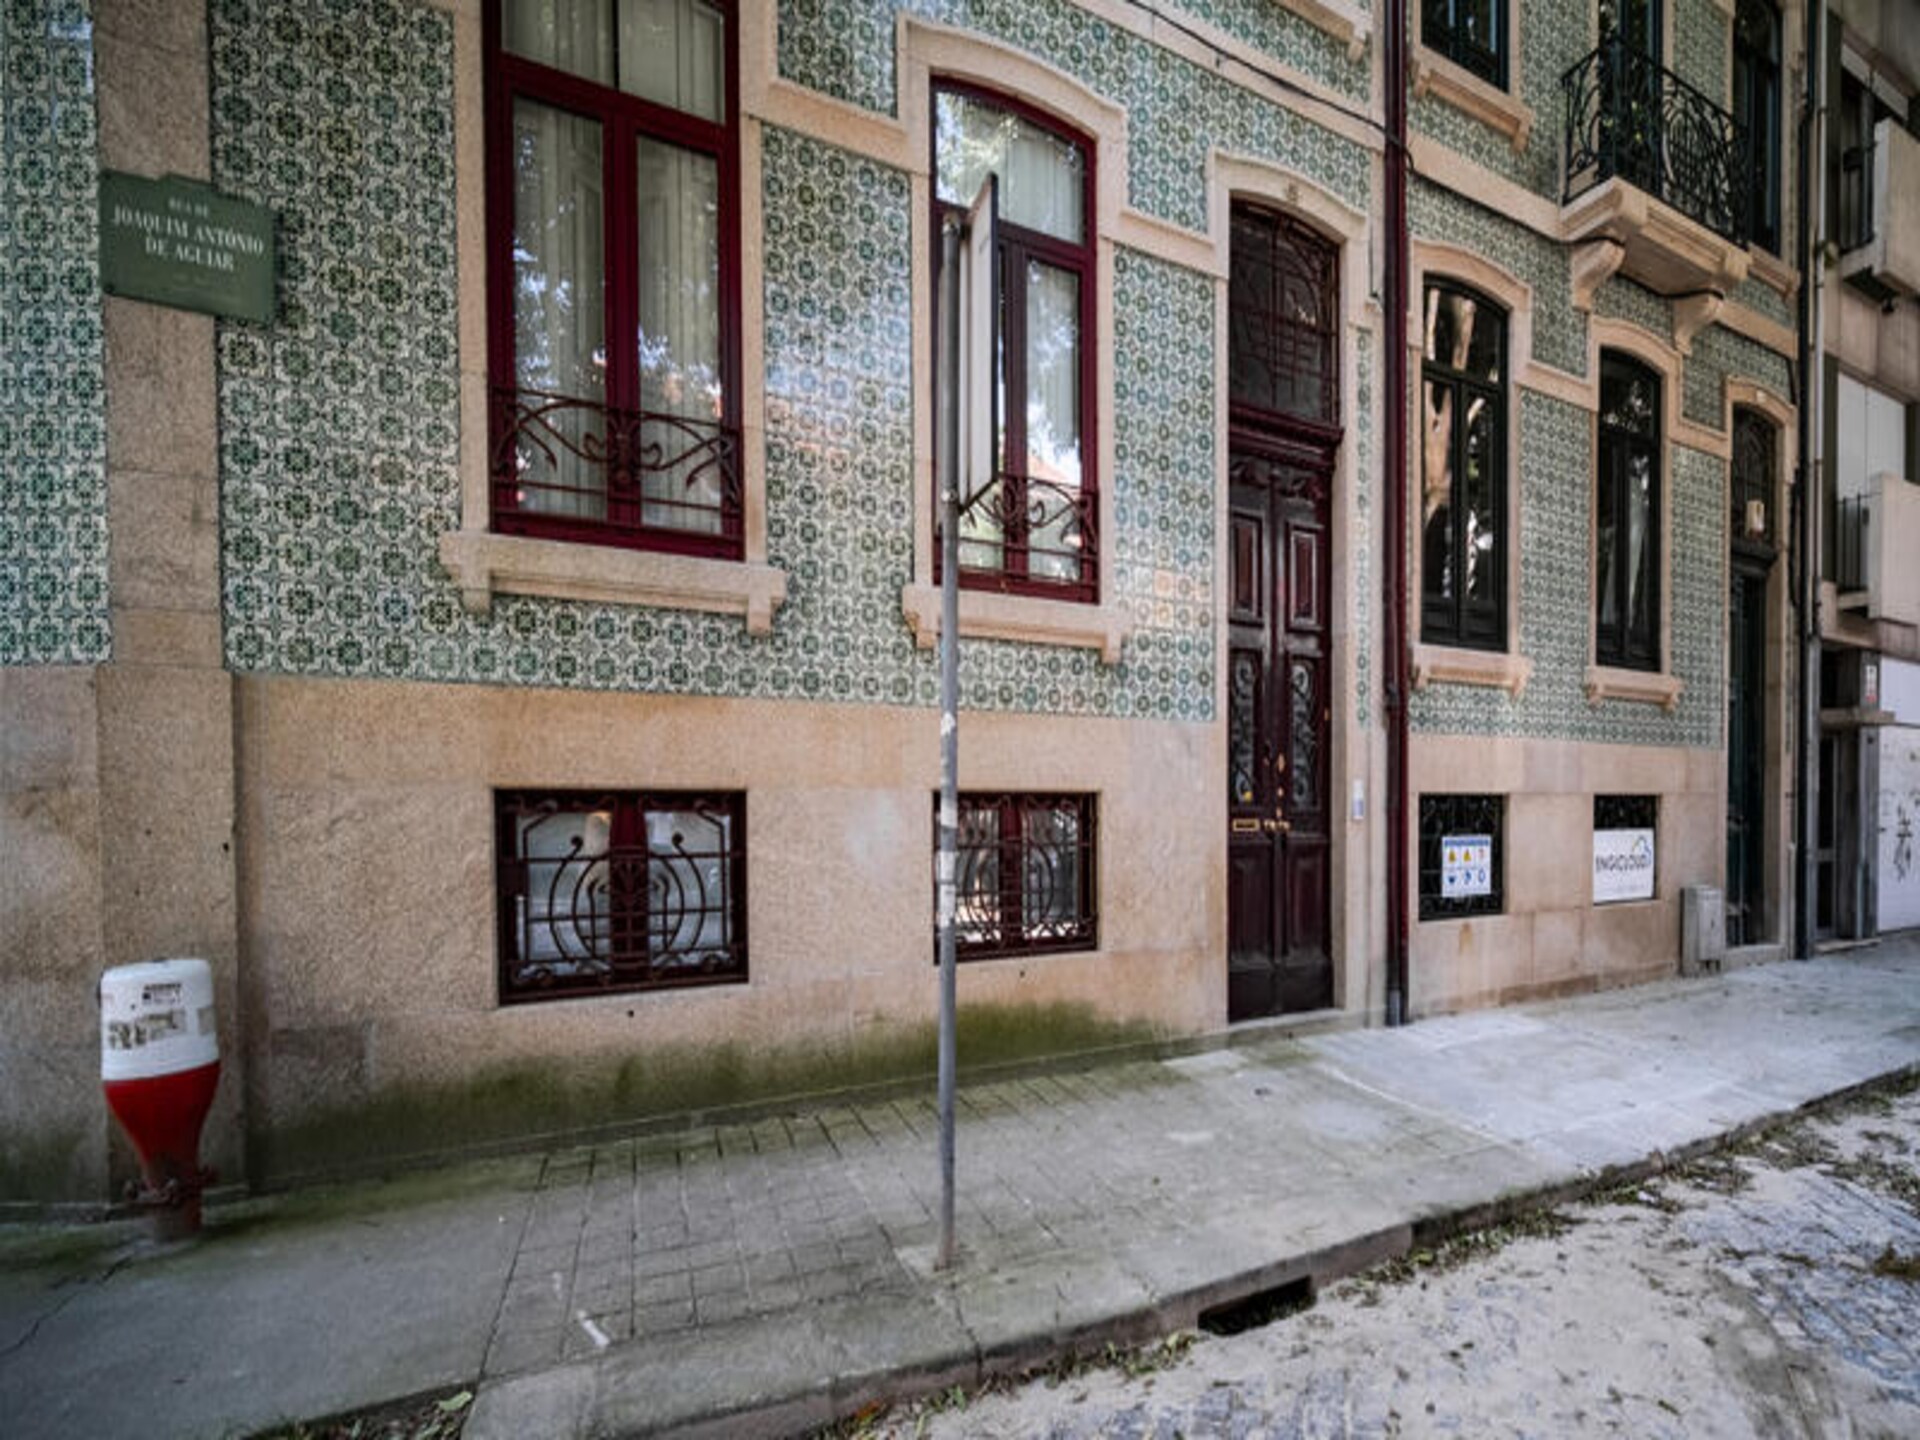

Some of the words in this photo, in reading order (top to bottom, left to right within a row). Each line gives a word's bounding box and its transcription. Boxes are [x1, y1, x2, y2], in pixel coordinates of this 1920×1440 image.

[112, 204, 188, 239] JOAQUIM
[145, 236, 168, 259] DE
[176, 243, 234, 272] AGUIAR
